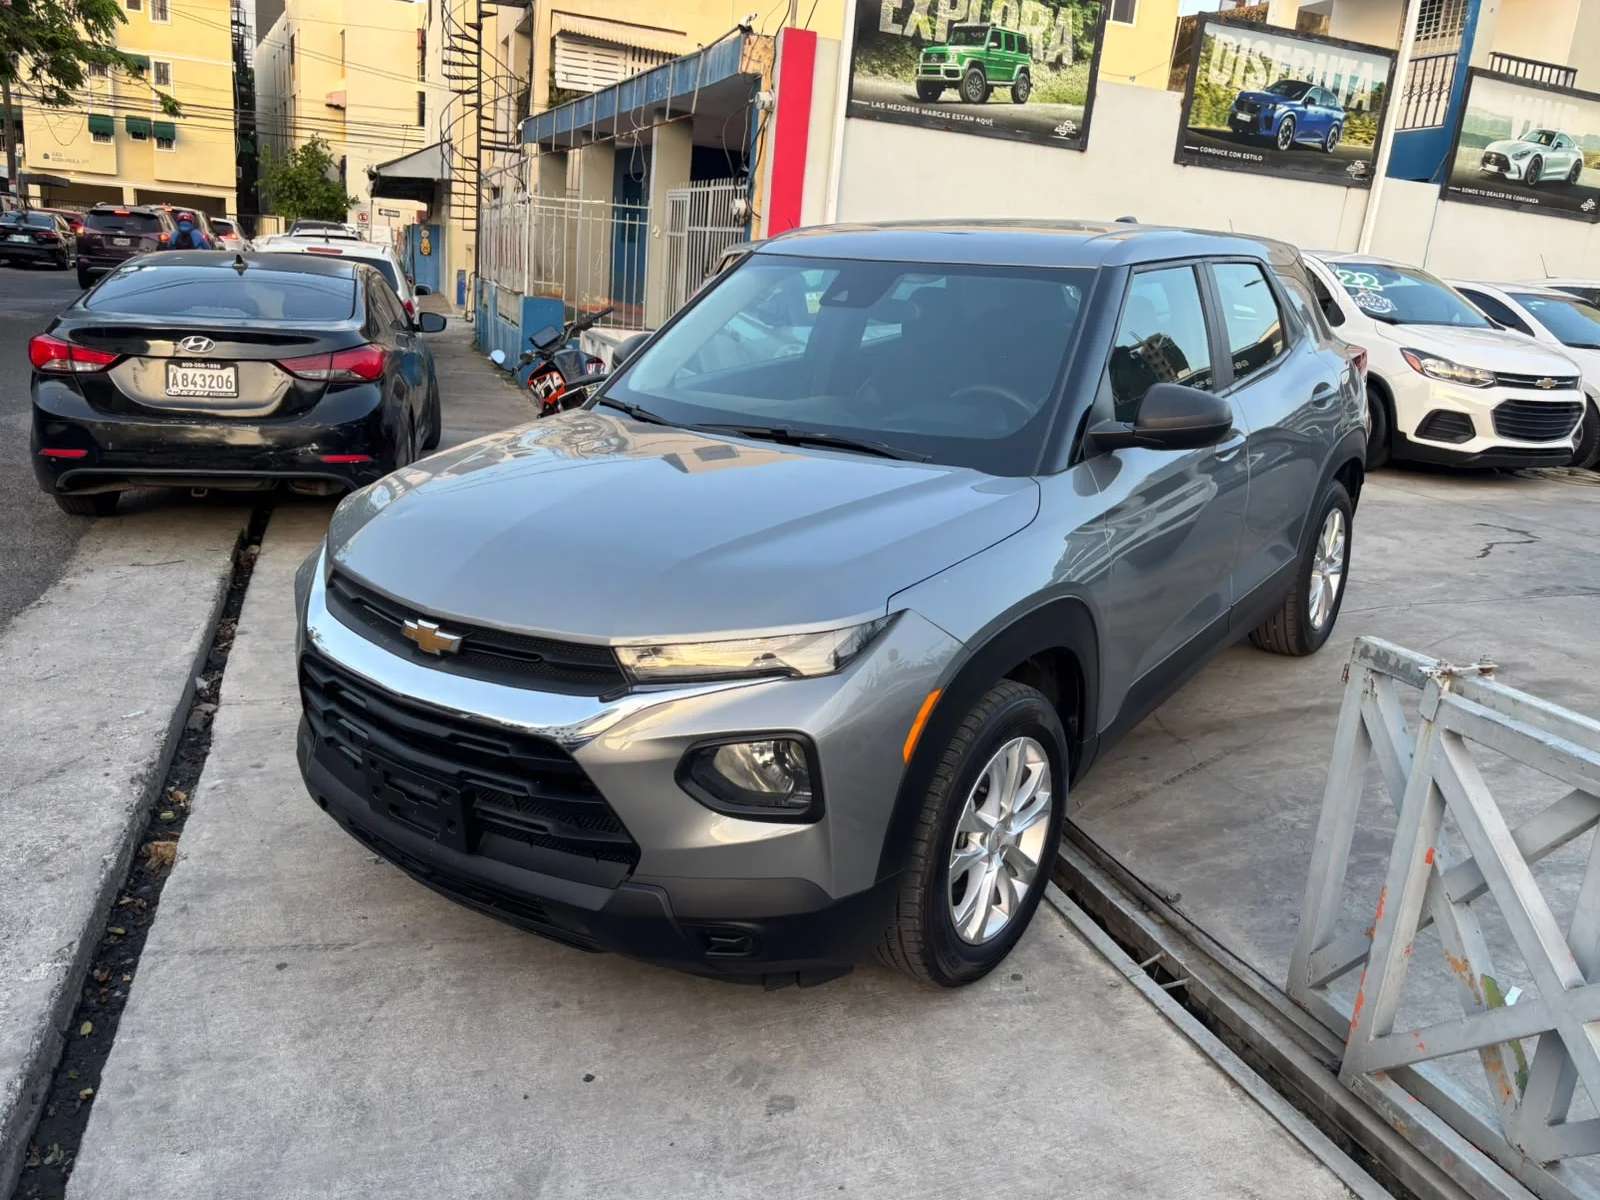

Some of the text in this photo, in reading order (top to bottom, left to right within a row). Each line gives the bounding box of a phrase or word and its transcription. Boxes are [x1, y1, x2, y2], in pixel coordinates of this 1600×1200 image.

[871, 101, 885, 109] LAS
[887, 103, 920, 114] MEJORES
[921, 108, 951, 119] MARCAS
[1200, 146, 1263, 161] CONDUCE CON ESTILO
[1461, 187, 1479, 195] SOMOS
[1336, 269, 1383, 291] 22
[172, 373, 232, 390] A843206
